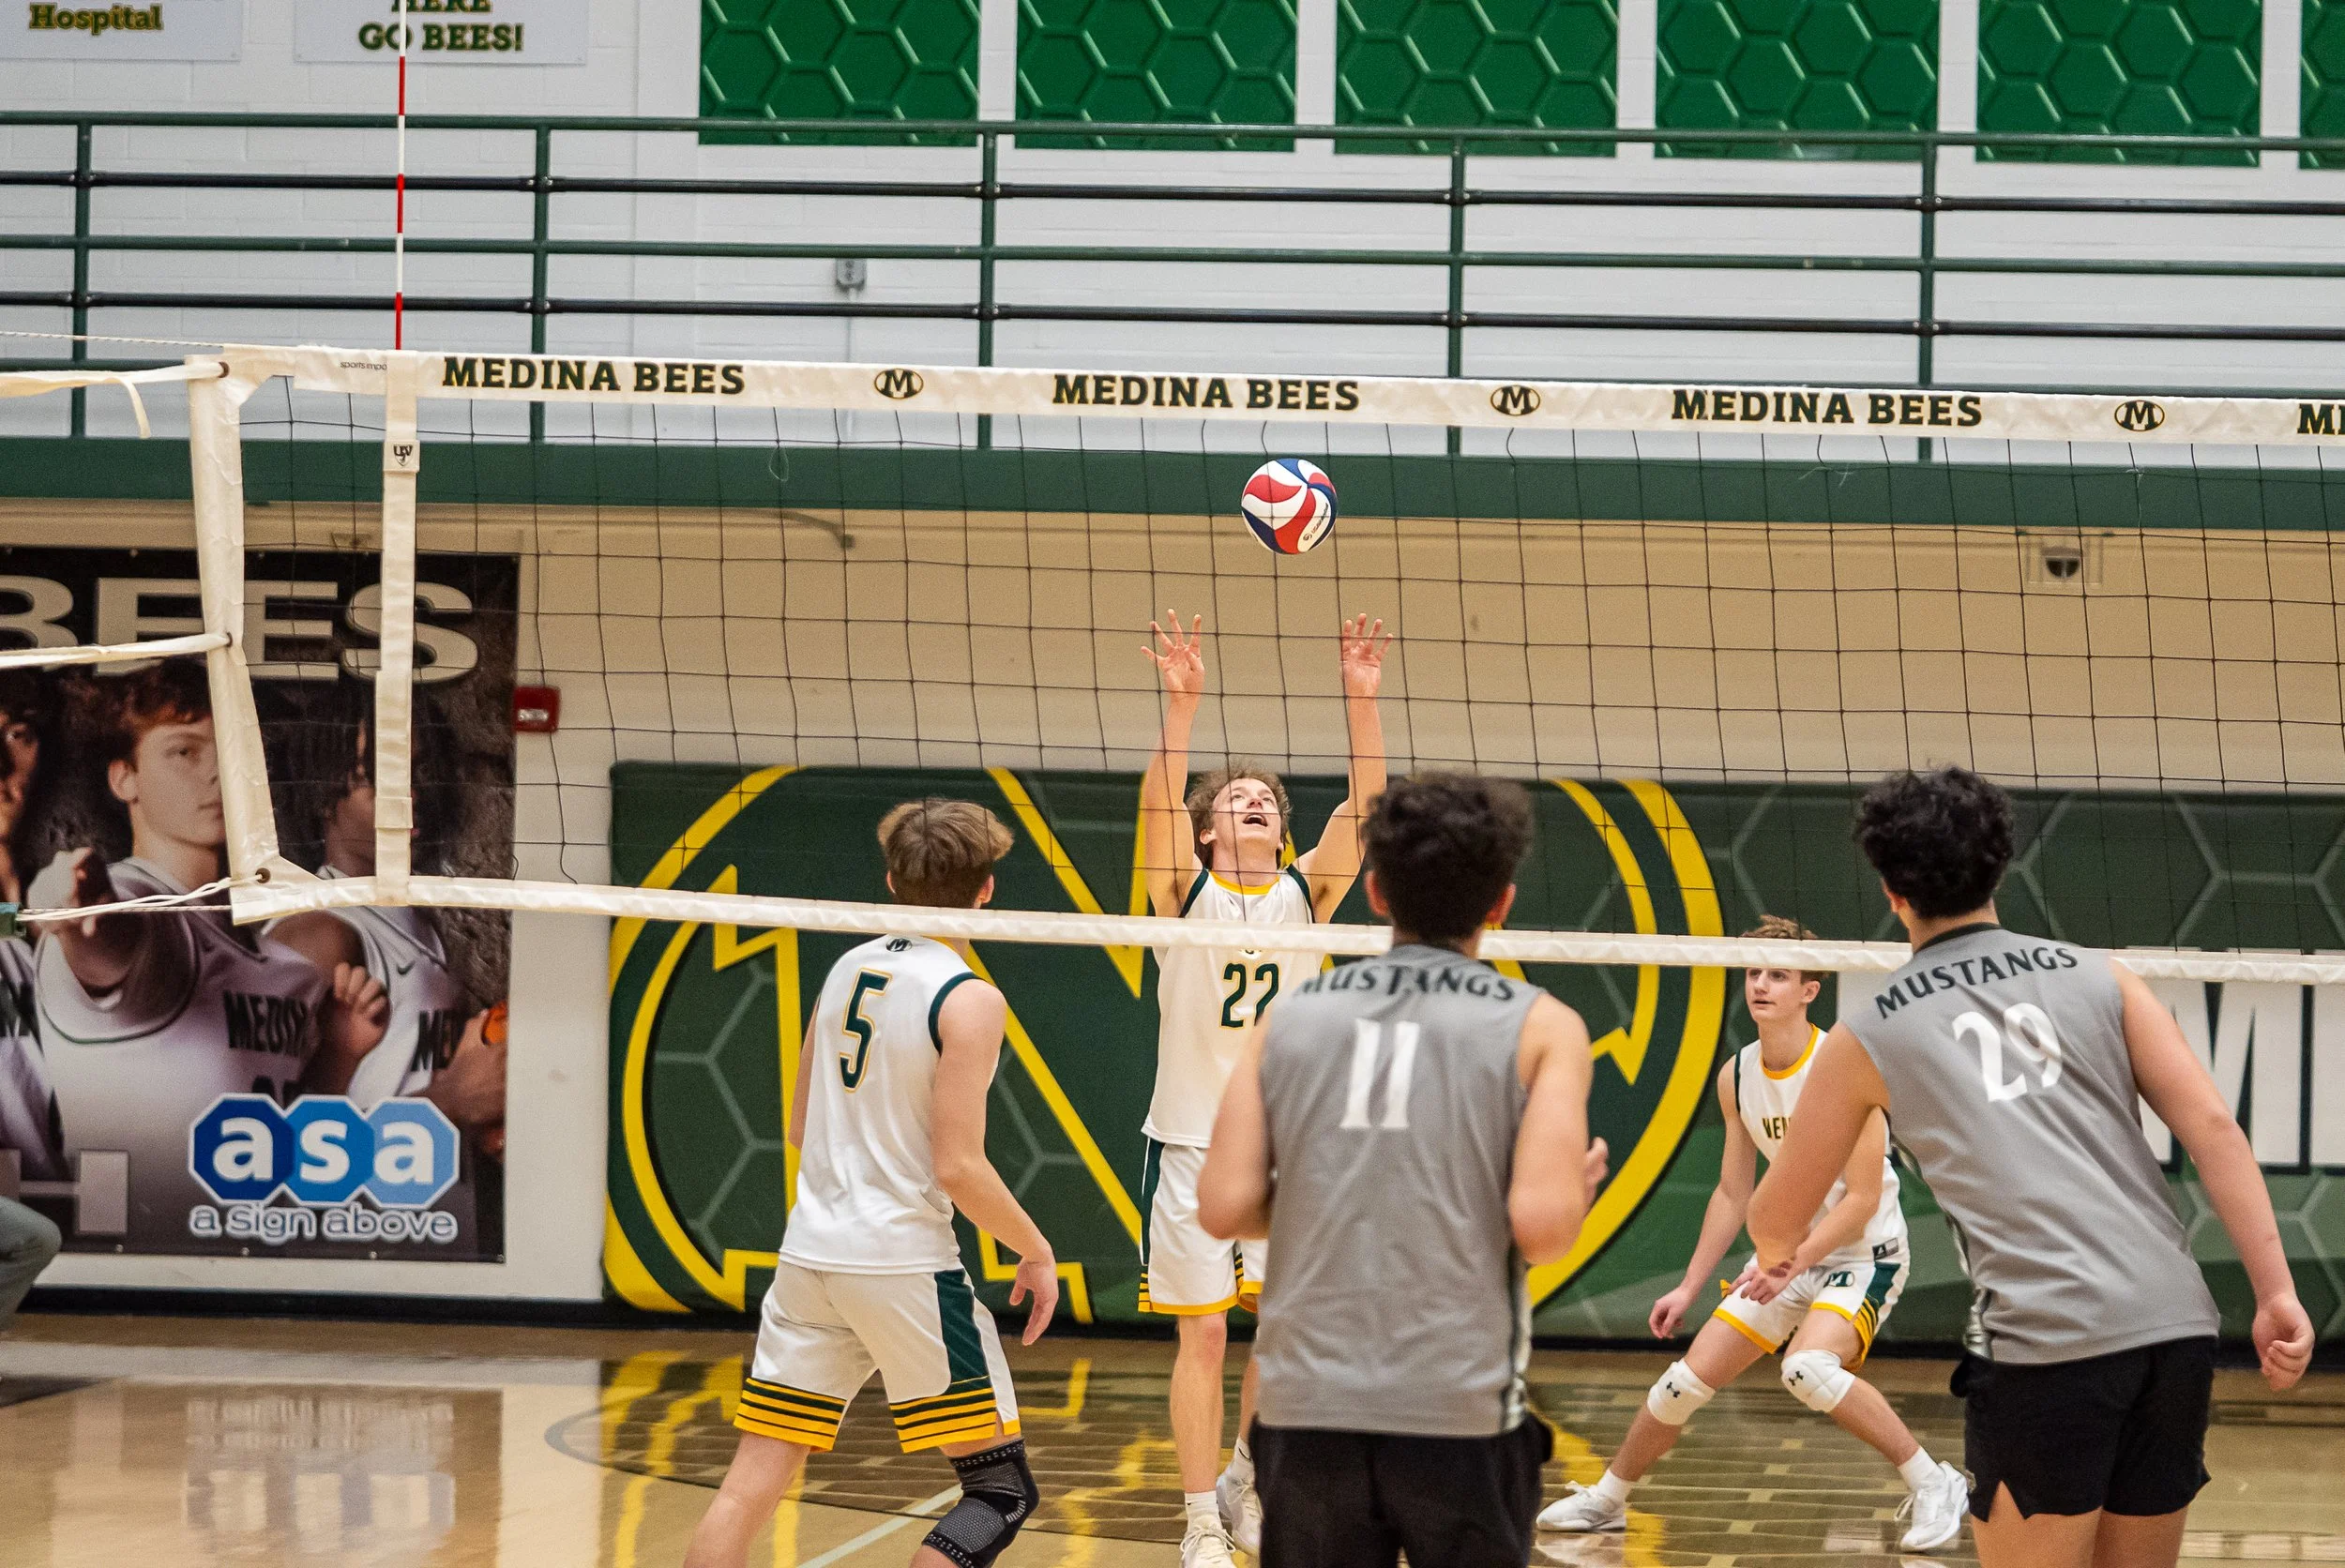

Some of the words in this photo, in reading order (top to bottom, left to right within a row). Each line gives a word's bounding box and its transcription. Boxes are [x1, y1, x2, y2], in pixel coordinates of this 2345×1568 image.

[29, 4, 163, 36] Hospital
[358, 23, 413, 51] GO
[422, 23, 522, 52] BEES!
[442, 356, 621, 391] MEDINA
[633, 362, 745, 395] BEES
[1051, 374, 1233, 409] MEDINA
[1247, 379, 1359, 412] BEES
[1672, 388, 1853, 425] MEDINA
[1868, 393, 1982, 428] BEES
[1874, 945, 2079, 1020] MUSTANGS
[839, 967, 893, 1093] 5
[1339, 1018, 1421, 1129] 11
[1951, 1001, 2064, 1103] 29
[212, 1116, 434, 1184] asa
[189, 1204, 222, 1238] a
[225, 1201, 318, 1244] sign
[322, 1201, 459, 1244] above
